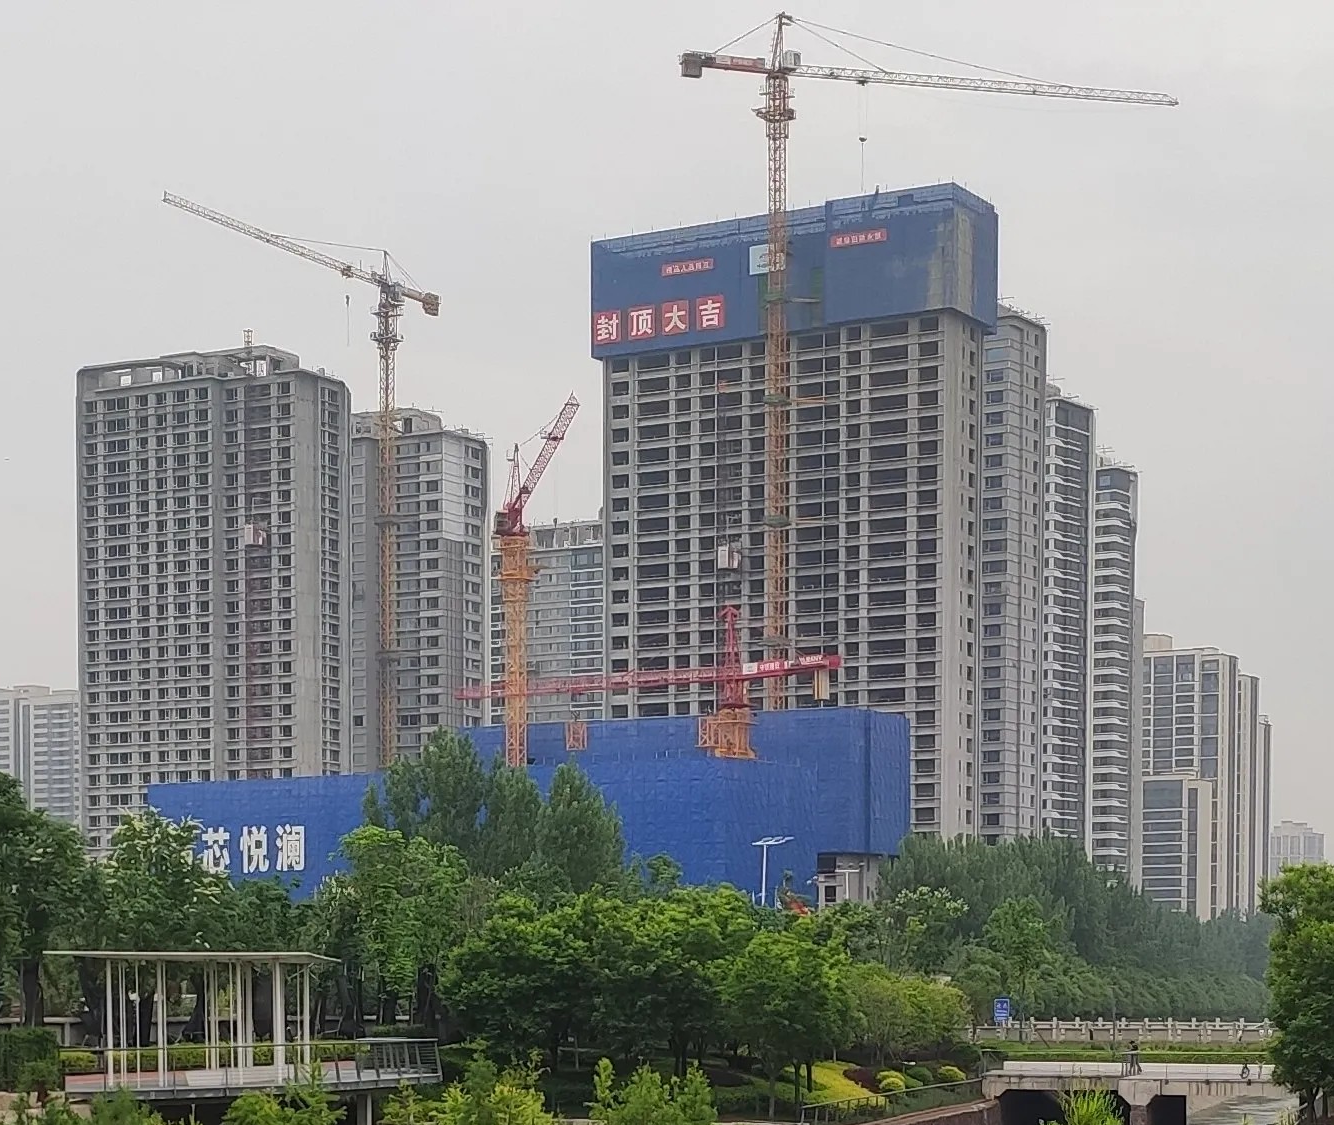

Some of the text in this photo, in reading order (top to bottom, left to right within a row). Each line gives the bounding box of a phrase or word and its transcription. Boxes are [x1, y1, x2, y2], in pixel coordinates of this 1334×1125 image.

[596, 299, 722, 341] 封顶大吉
[180, 823, 306, 874] 芯悦澜
